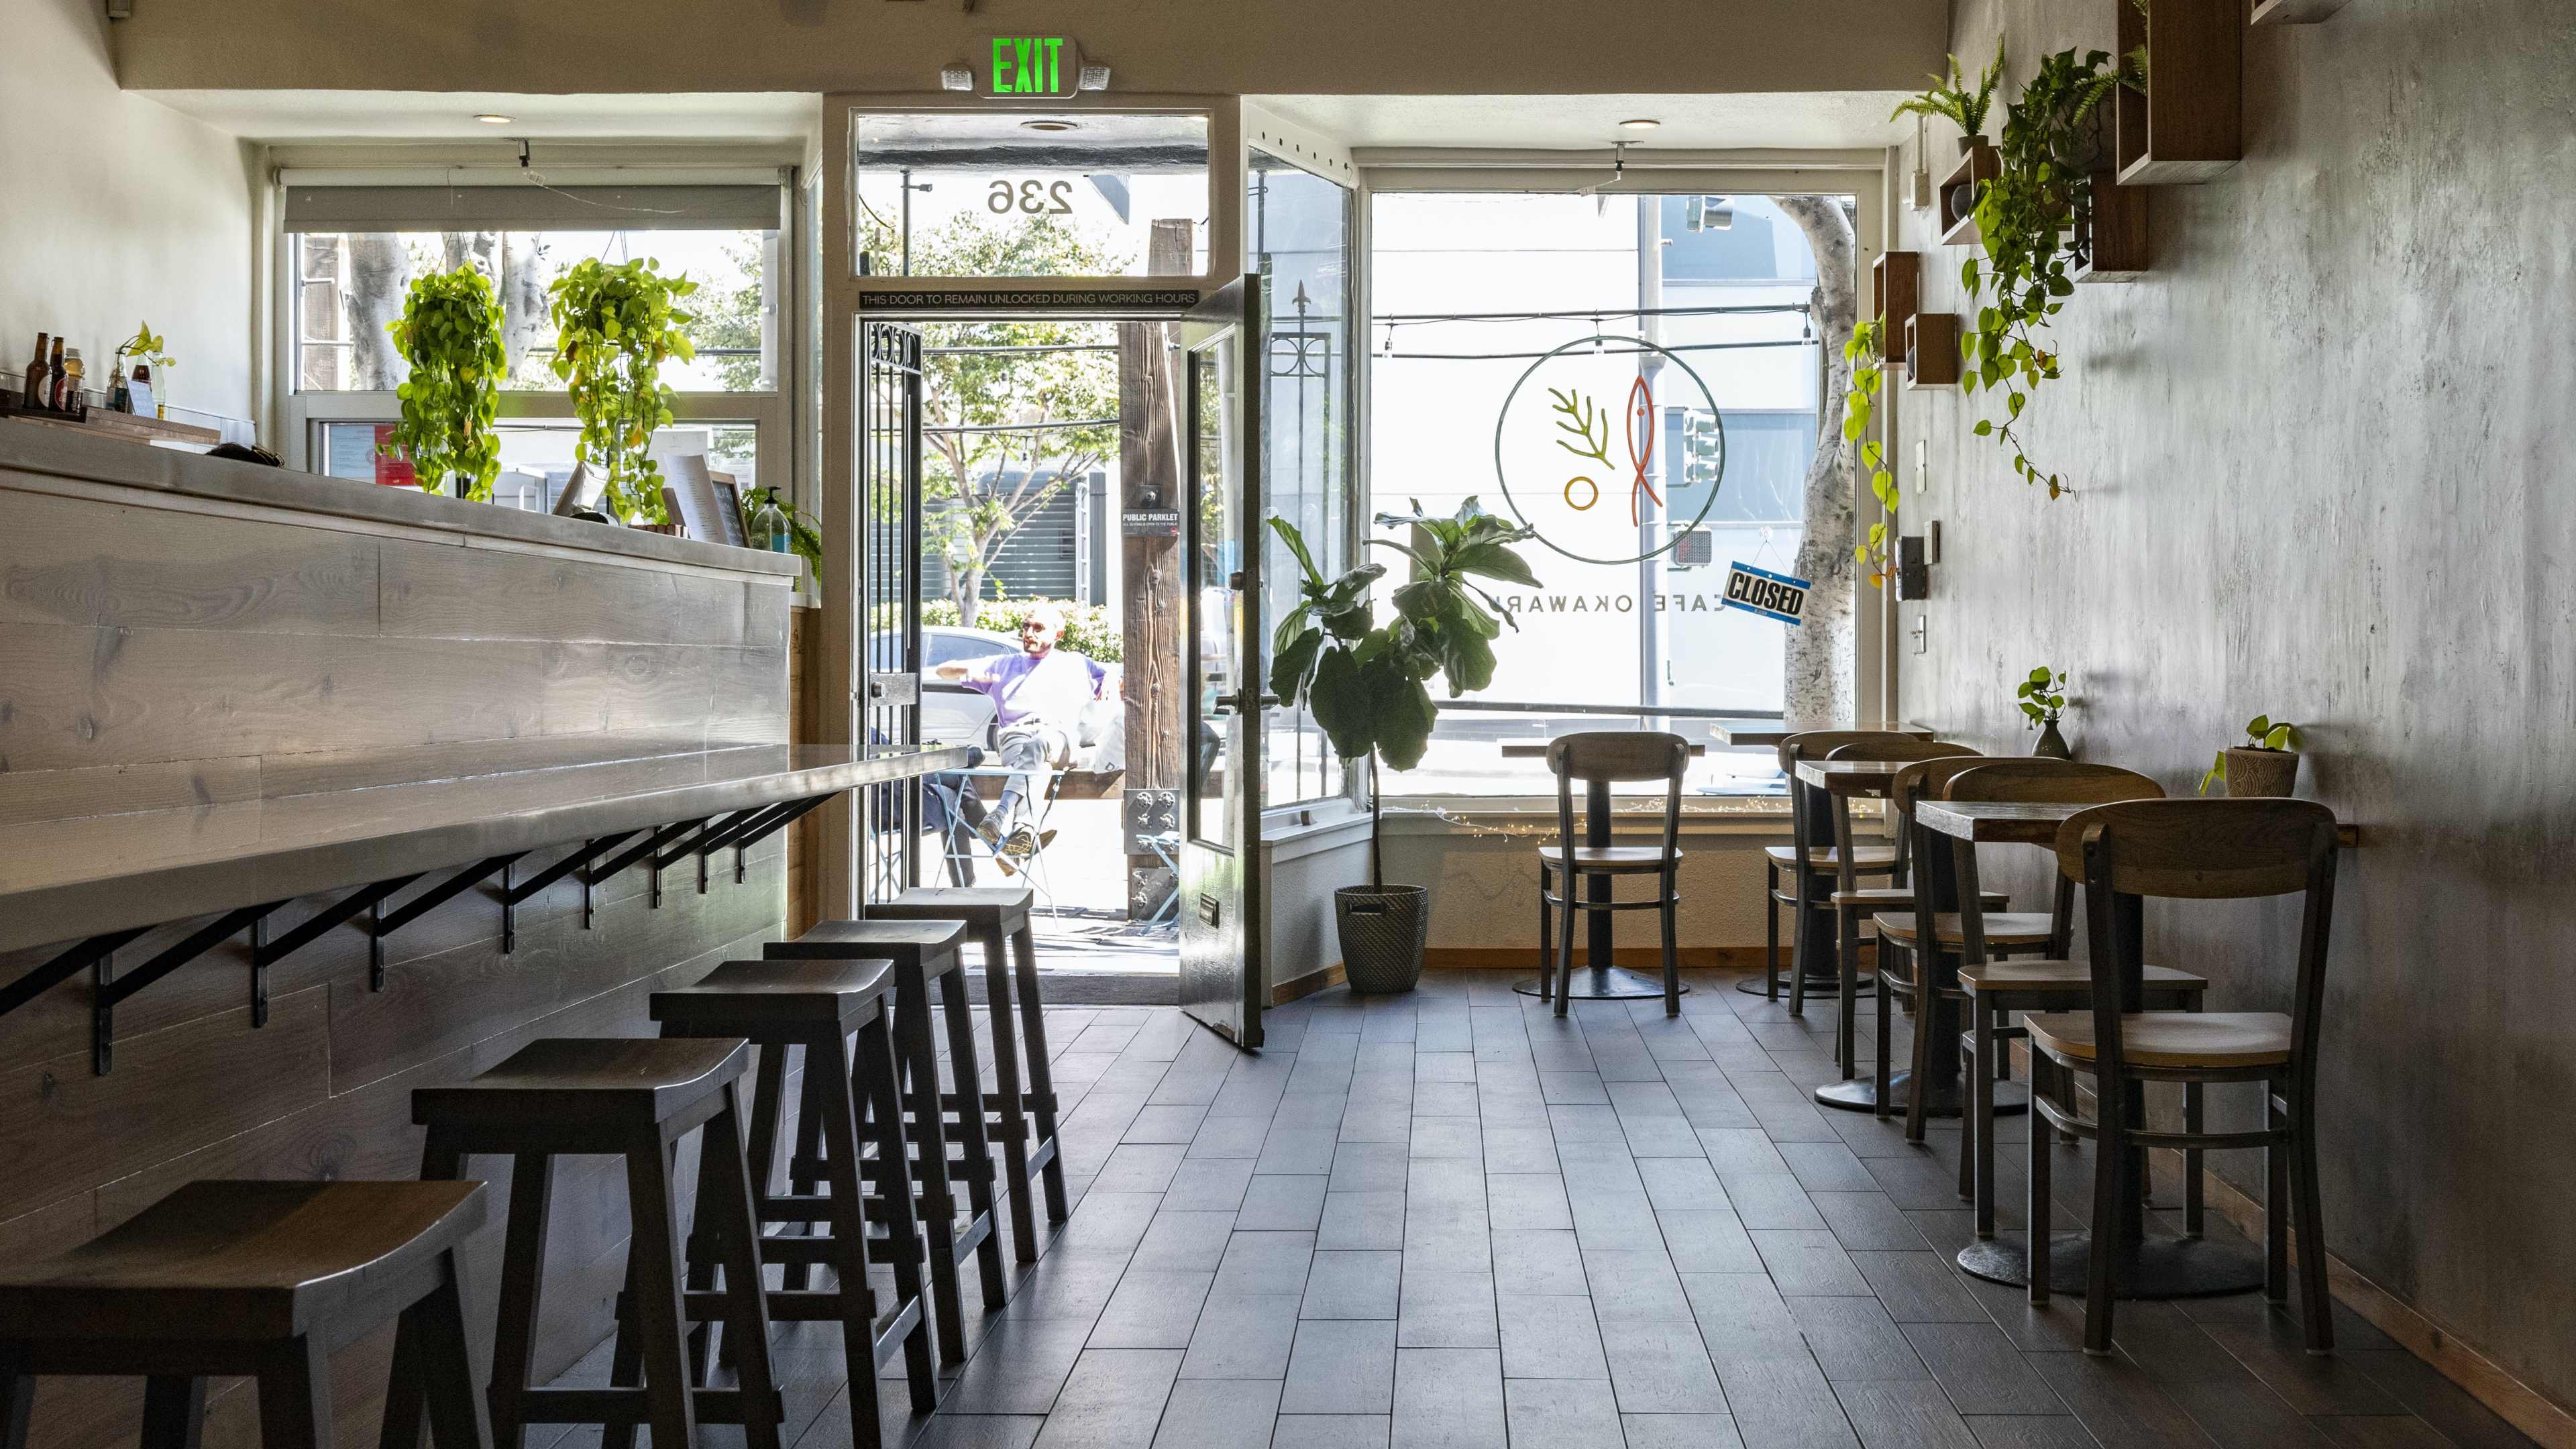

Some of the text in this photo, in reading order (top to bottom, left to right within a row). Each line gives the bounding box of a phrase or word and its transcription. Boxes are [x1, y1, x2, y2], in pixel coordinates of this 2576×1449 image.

[992, 38, 1063, 93] EXIT
[863, 294, 1195, 305] THIS DOOR TO REMAIN UNLOCKED DURING WORKING HOURS
[1122, 513, 1178, 521] PUBLIC PARKLET
[1727, 572, 1805, 615] CLOSED
